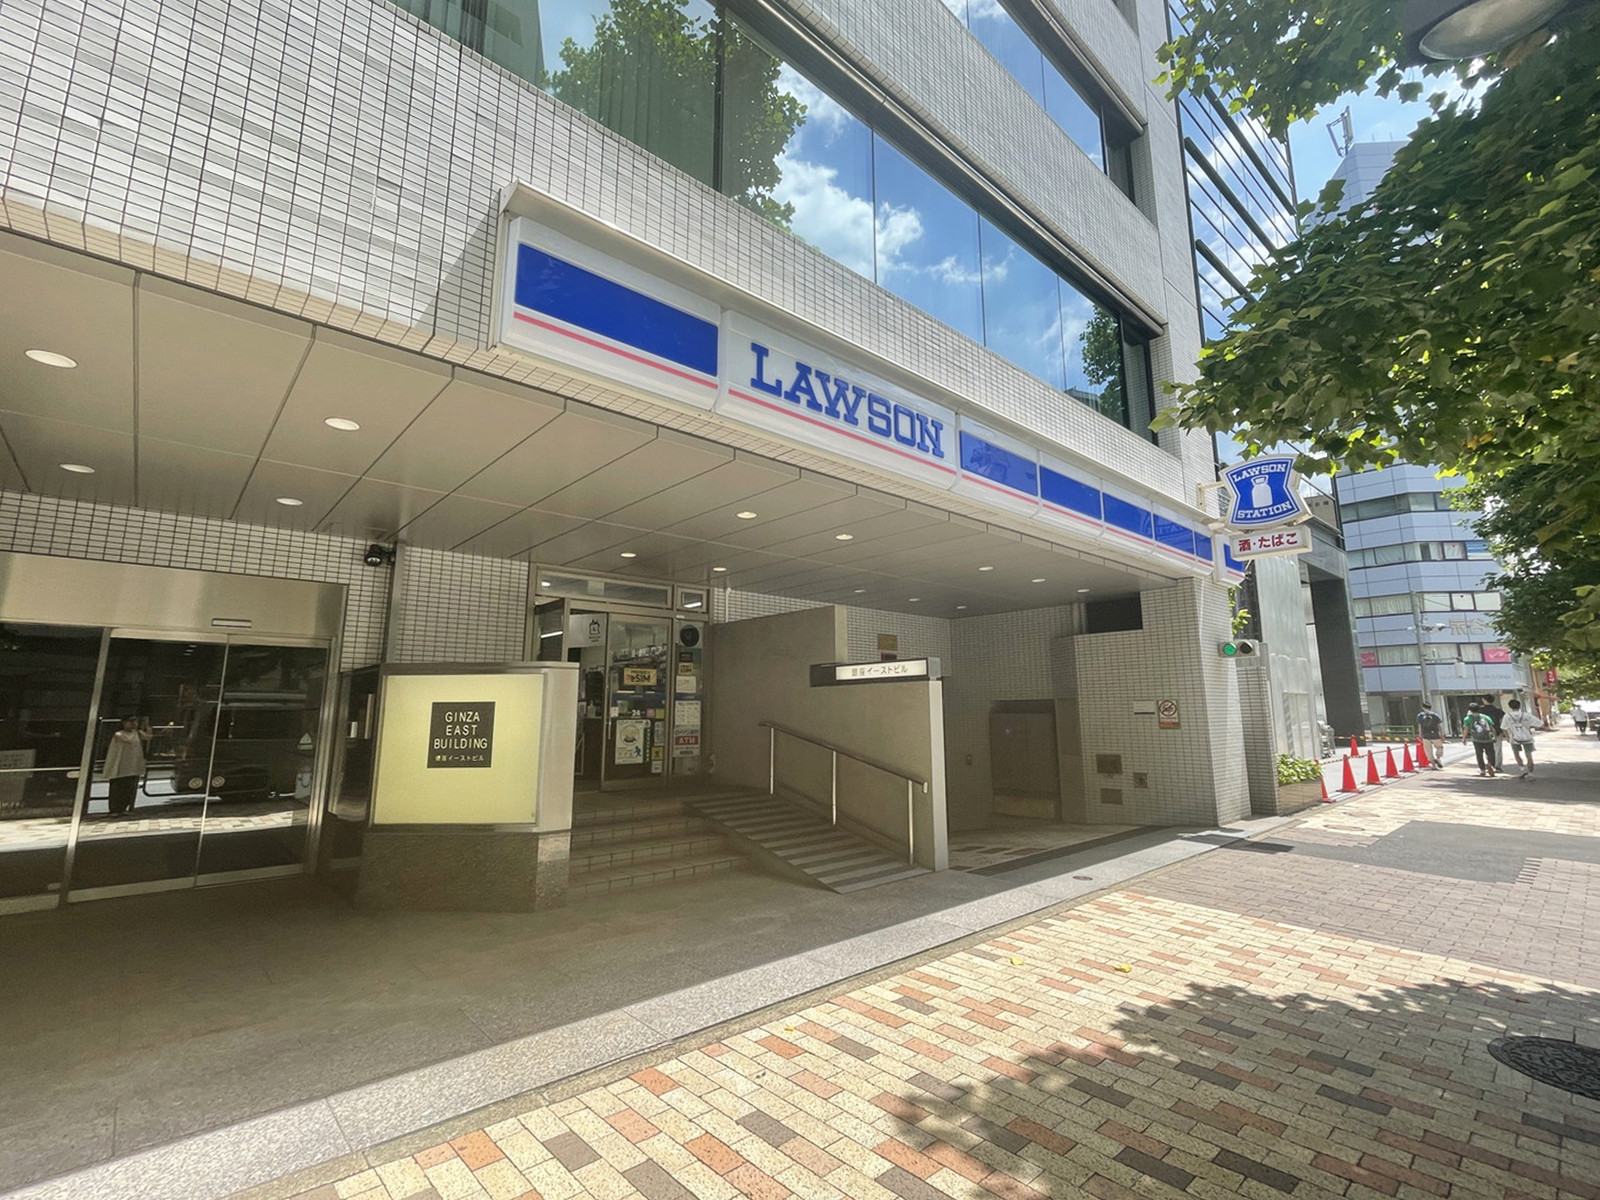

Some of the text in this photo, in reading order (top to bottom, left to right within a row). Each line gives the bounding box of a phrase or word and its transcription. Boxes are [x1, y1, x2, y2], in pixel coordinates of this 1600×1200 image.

[751, 342, 944, 459] LAWSON
[1231, 463, 1287, 483] LAWSON
[1237, 500, 1292, 519] STATION
[1239, 533, 1297, 552] 酒・たばこ
[445, 711, 480, 722] GINZA
[445, 724, 478, 736] EAST
[433, 738, 488, 749] BUILDING
